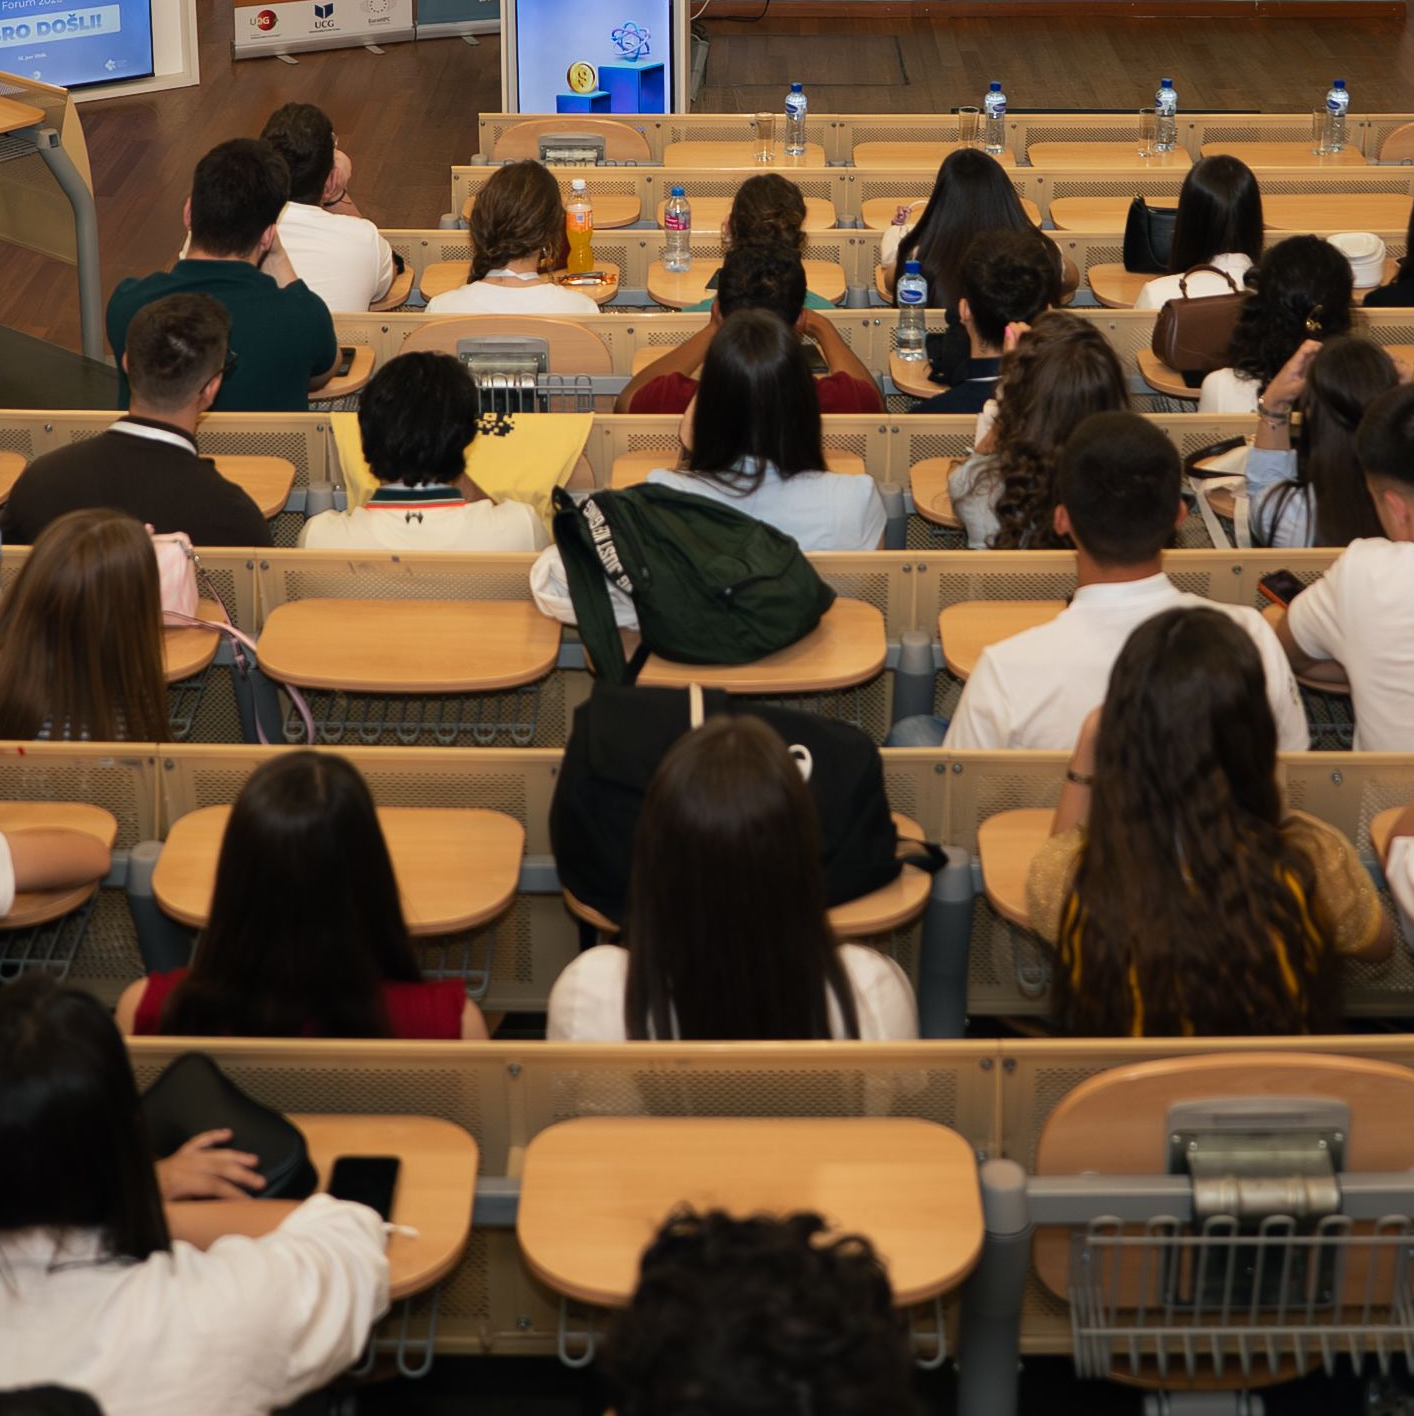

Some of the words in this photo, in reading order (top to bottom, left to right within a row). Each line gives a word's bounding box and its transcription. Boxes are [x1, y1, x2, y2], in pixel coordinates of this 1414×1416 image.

[37, 13, 102, 35] DOŠLI!
[250, 16, 270, 26] UDG
[315, 20, 335, 29] UCG
[595, 540, 624, 573] JUST
